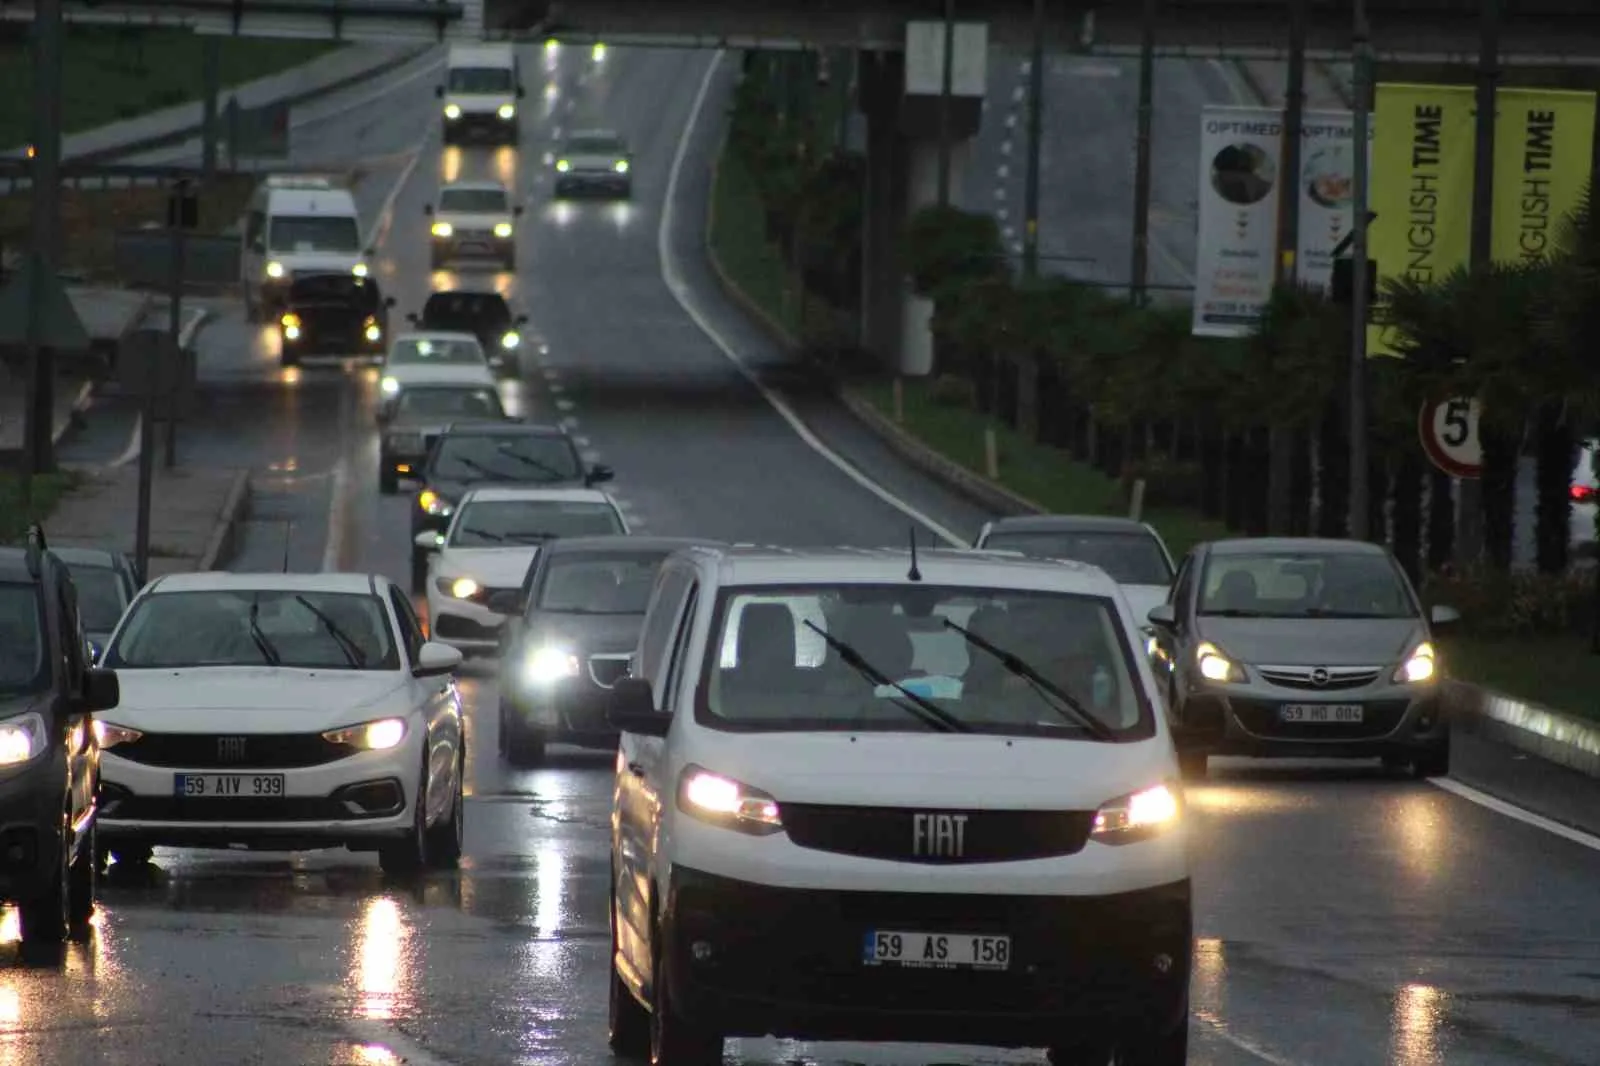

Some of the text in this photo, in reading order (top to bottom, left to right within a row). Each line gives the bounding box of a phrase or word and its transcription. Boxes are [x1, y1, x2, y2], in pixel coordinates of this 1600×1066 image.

[1206, 120, 1282, 136] OPTIMED
[1406, 104, 1443, 284] ENGLISH TIME
[1519, 110, 1555, 262] GLISH TIME
[1443, 402, 1469, 446] 5
[1286, 706, 1303, 720] 59
[218, 736, 246, 762] FIAT
[185, 777, 281, 794] 59 AIV 939
[913, 814, 968, 856] FIAT
[877, 934, 1008, 962] 59 AS 158
